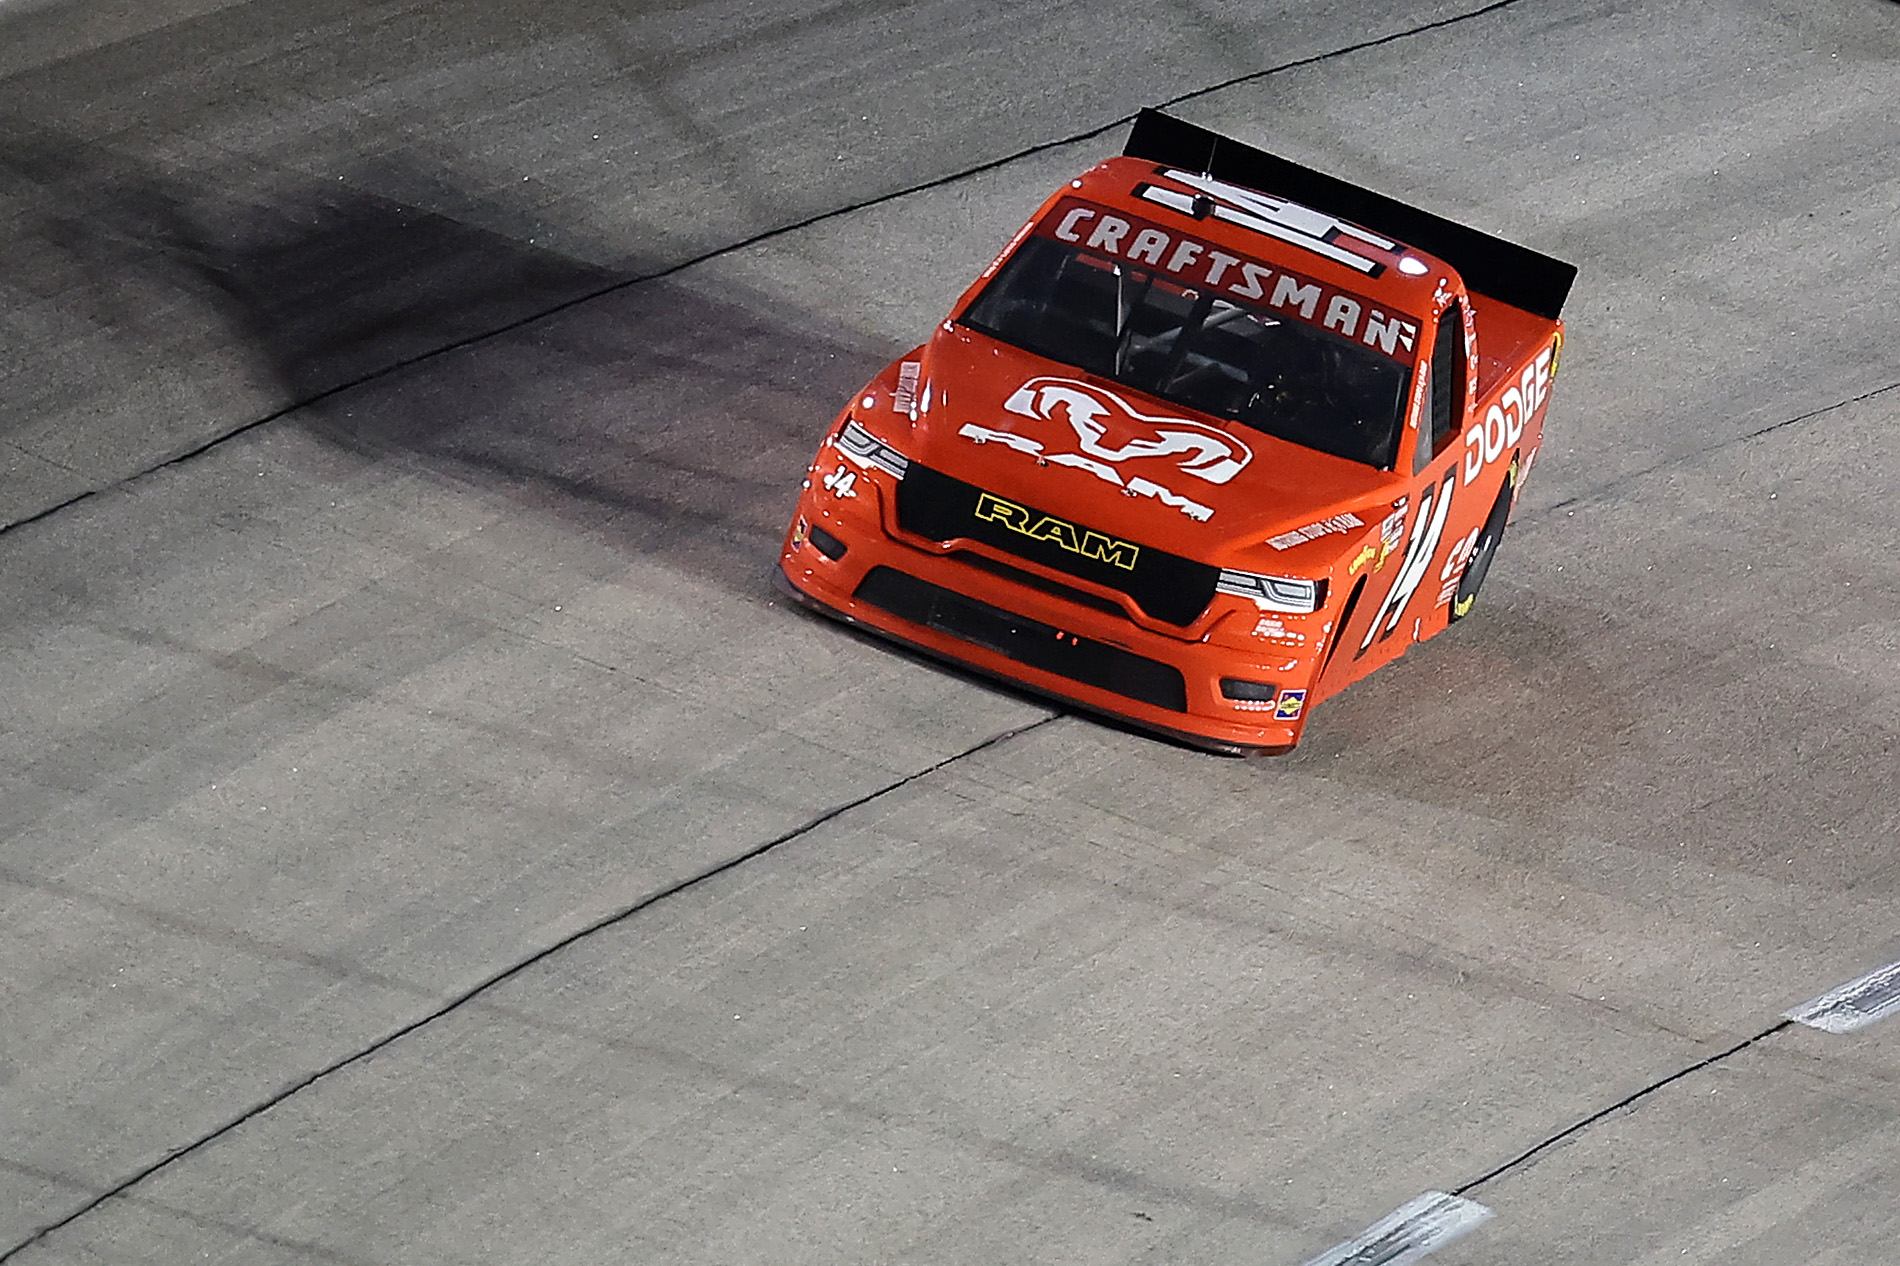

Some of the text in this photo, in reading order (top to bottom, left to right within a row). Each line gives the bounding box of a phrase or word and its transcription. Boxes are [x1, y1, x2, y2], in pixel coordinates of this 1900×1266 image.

[1054, 208, 1402, 356] CRAFTSMAN
[958, 422, 1216, 523] RAM
[1464, 346, 1552, 483] DODGE
[974, 492, 1140, 571] RAM
[1354, 466, 1457, 659] 14
